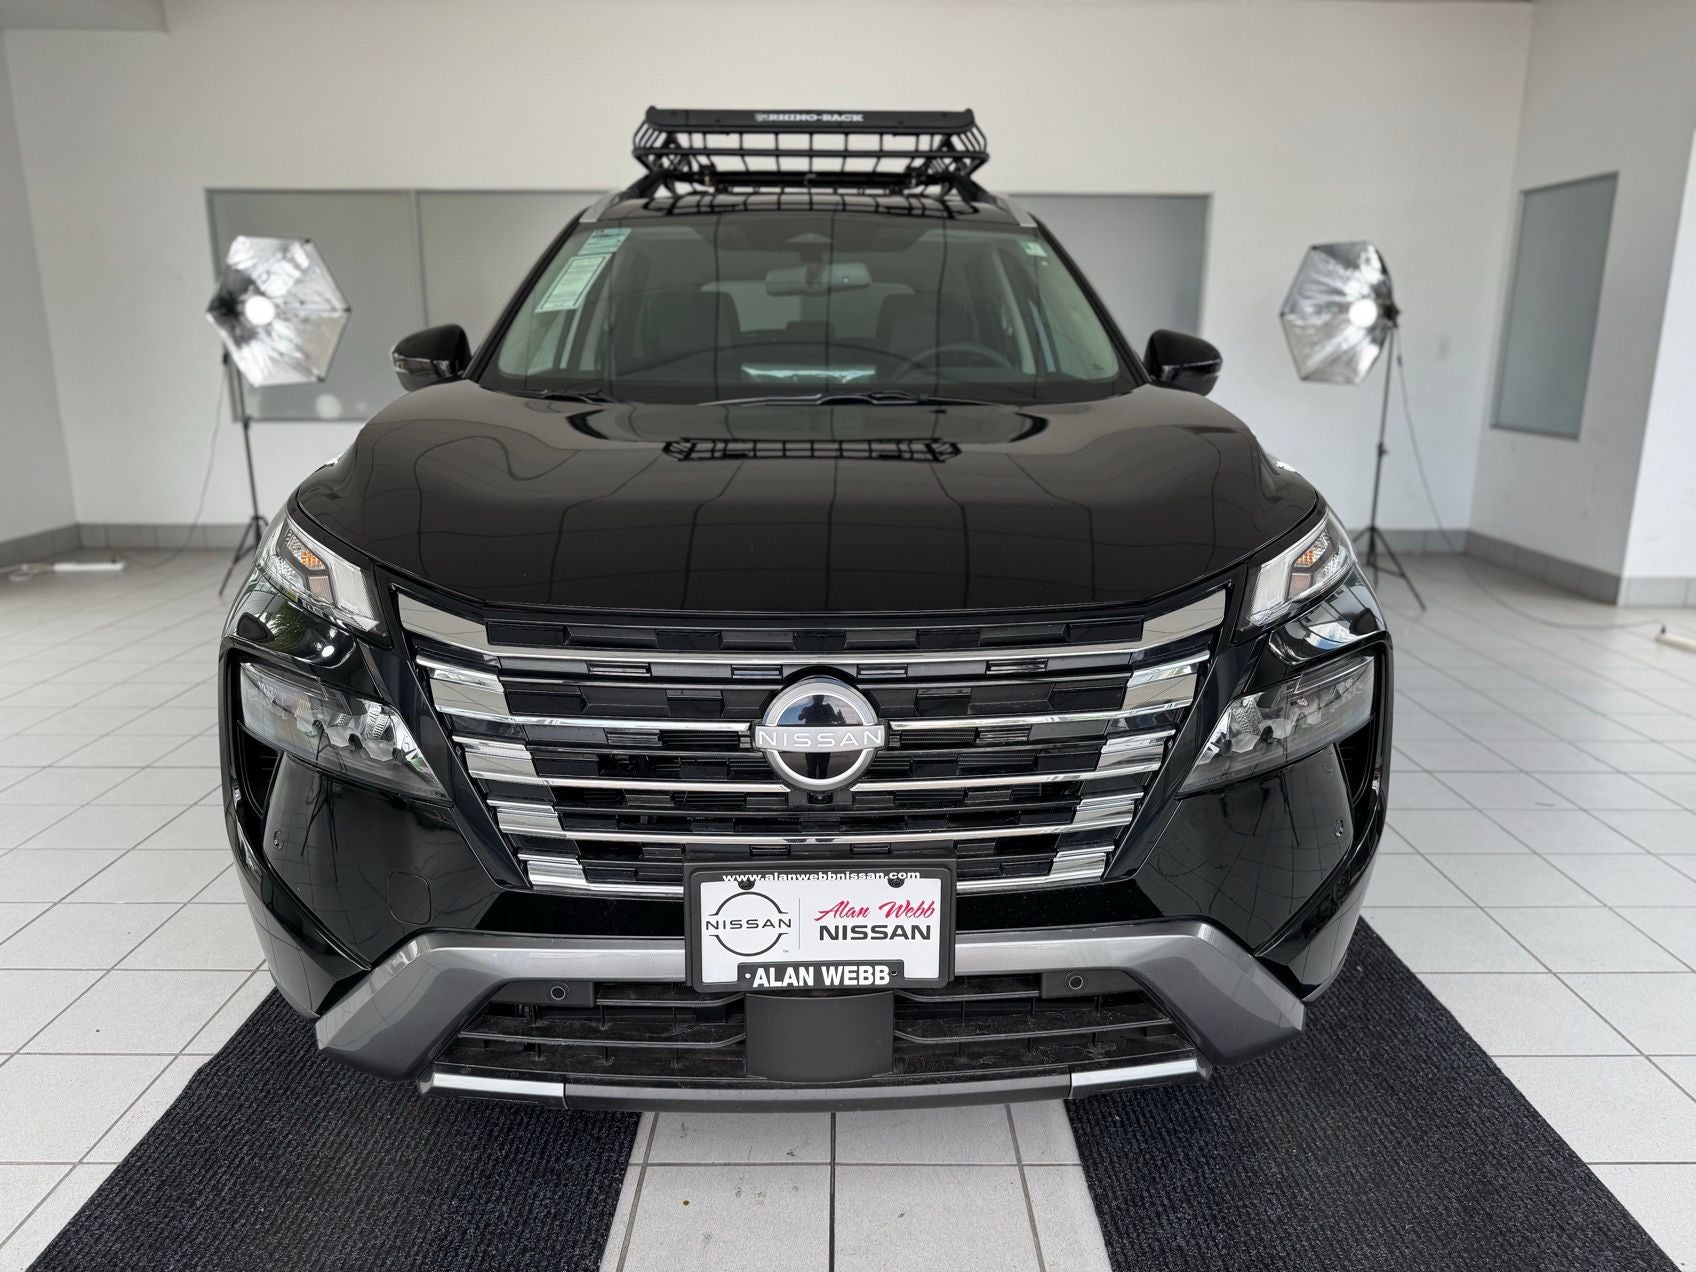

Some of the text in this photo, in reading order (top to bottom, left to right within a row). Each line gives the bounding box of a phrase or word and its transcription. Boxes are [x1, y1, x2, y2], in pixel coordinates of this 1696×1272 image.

[766, 113, 864, 122] RHINO-RACK
[759, 729, 881, 747] NISSAN
[722, 871, 920, 882] www.alanwebbnissan.com
[814, 899, 935, 921] Alan Webb
[706, 918, 792, 930] NISSAN
[819, 924, 931, 941] NISSAN
[752, 965, 890, 988] ALAN WEBB
